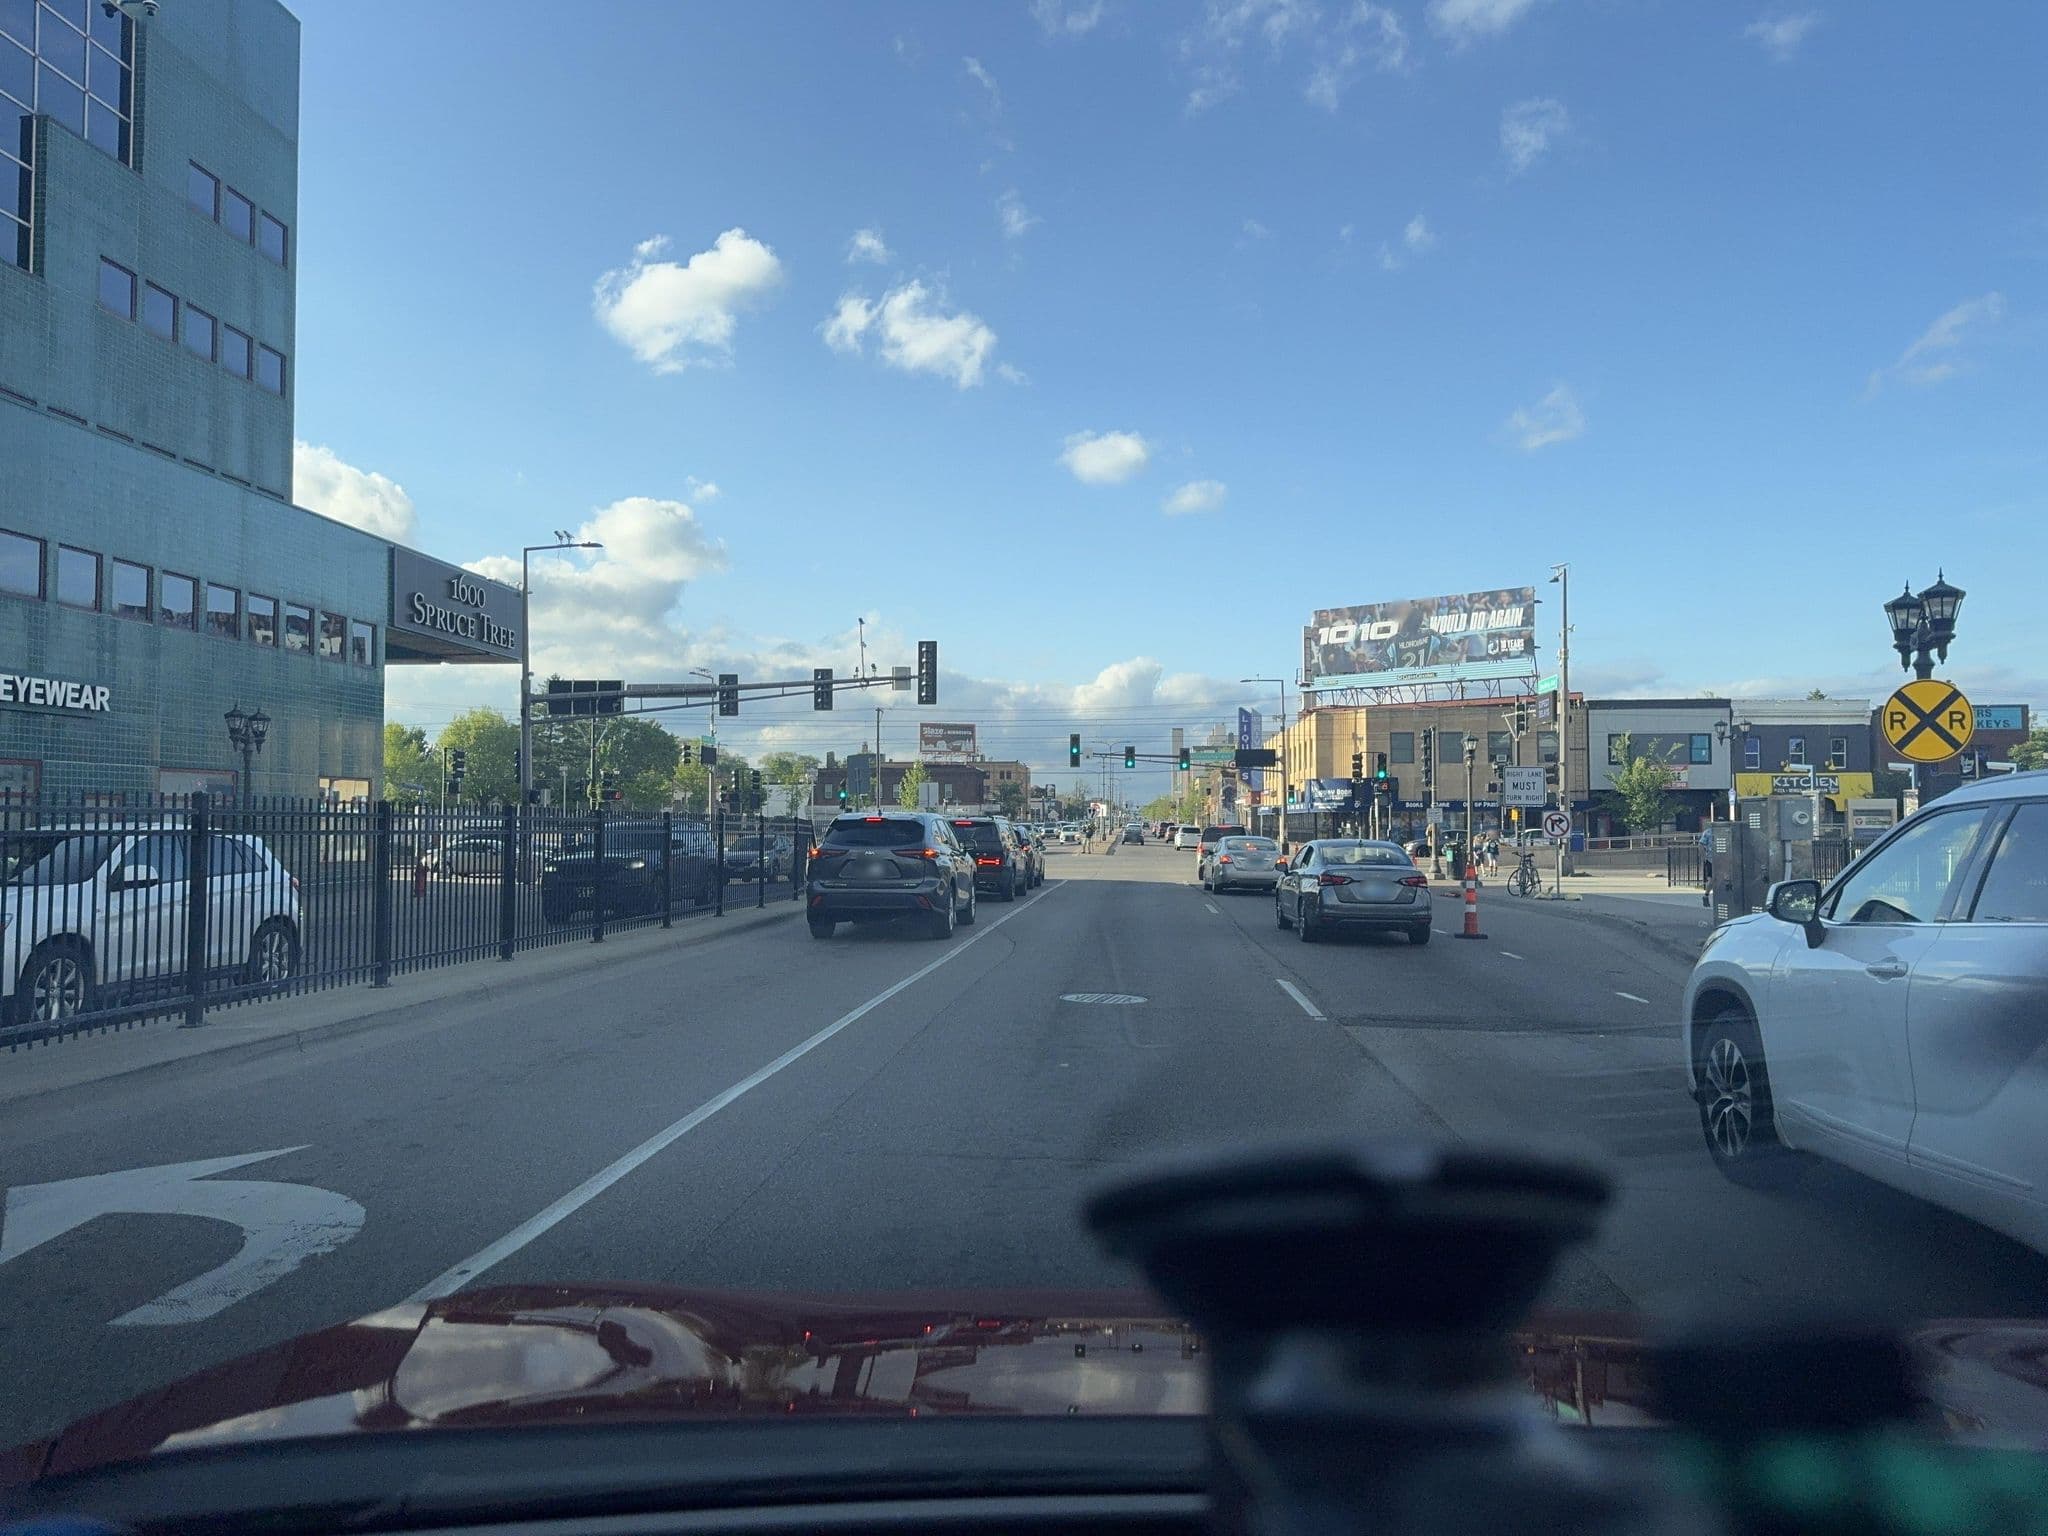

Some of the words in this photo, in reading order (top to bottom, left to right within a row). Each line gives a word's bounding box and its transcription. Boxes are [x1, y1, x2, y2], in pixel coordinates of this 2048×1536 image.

[451, 575, 486, 608] 1600
[1430, 613, 1467, 634] WOULD
[1470, 611, 1487, 631] DO
[1488, 607, 1524, 629] AGAIN
[1401, 649, 1425, 668] 21
[0, 673, 110, 711] EYEWEAR
[1889, 711, 1907, 731] R
[1949, 710, 1966, 730] R
[1976, 719, 2010, 728] KEYS
[1241, 715, 1249, 780] LIQUS
[1512, 782, 1537, 790] MUST
